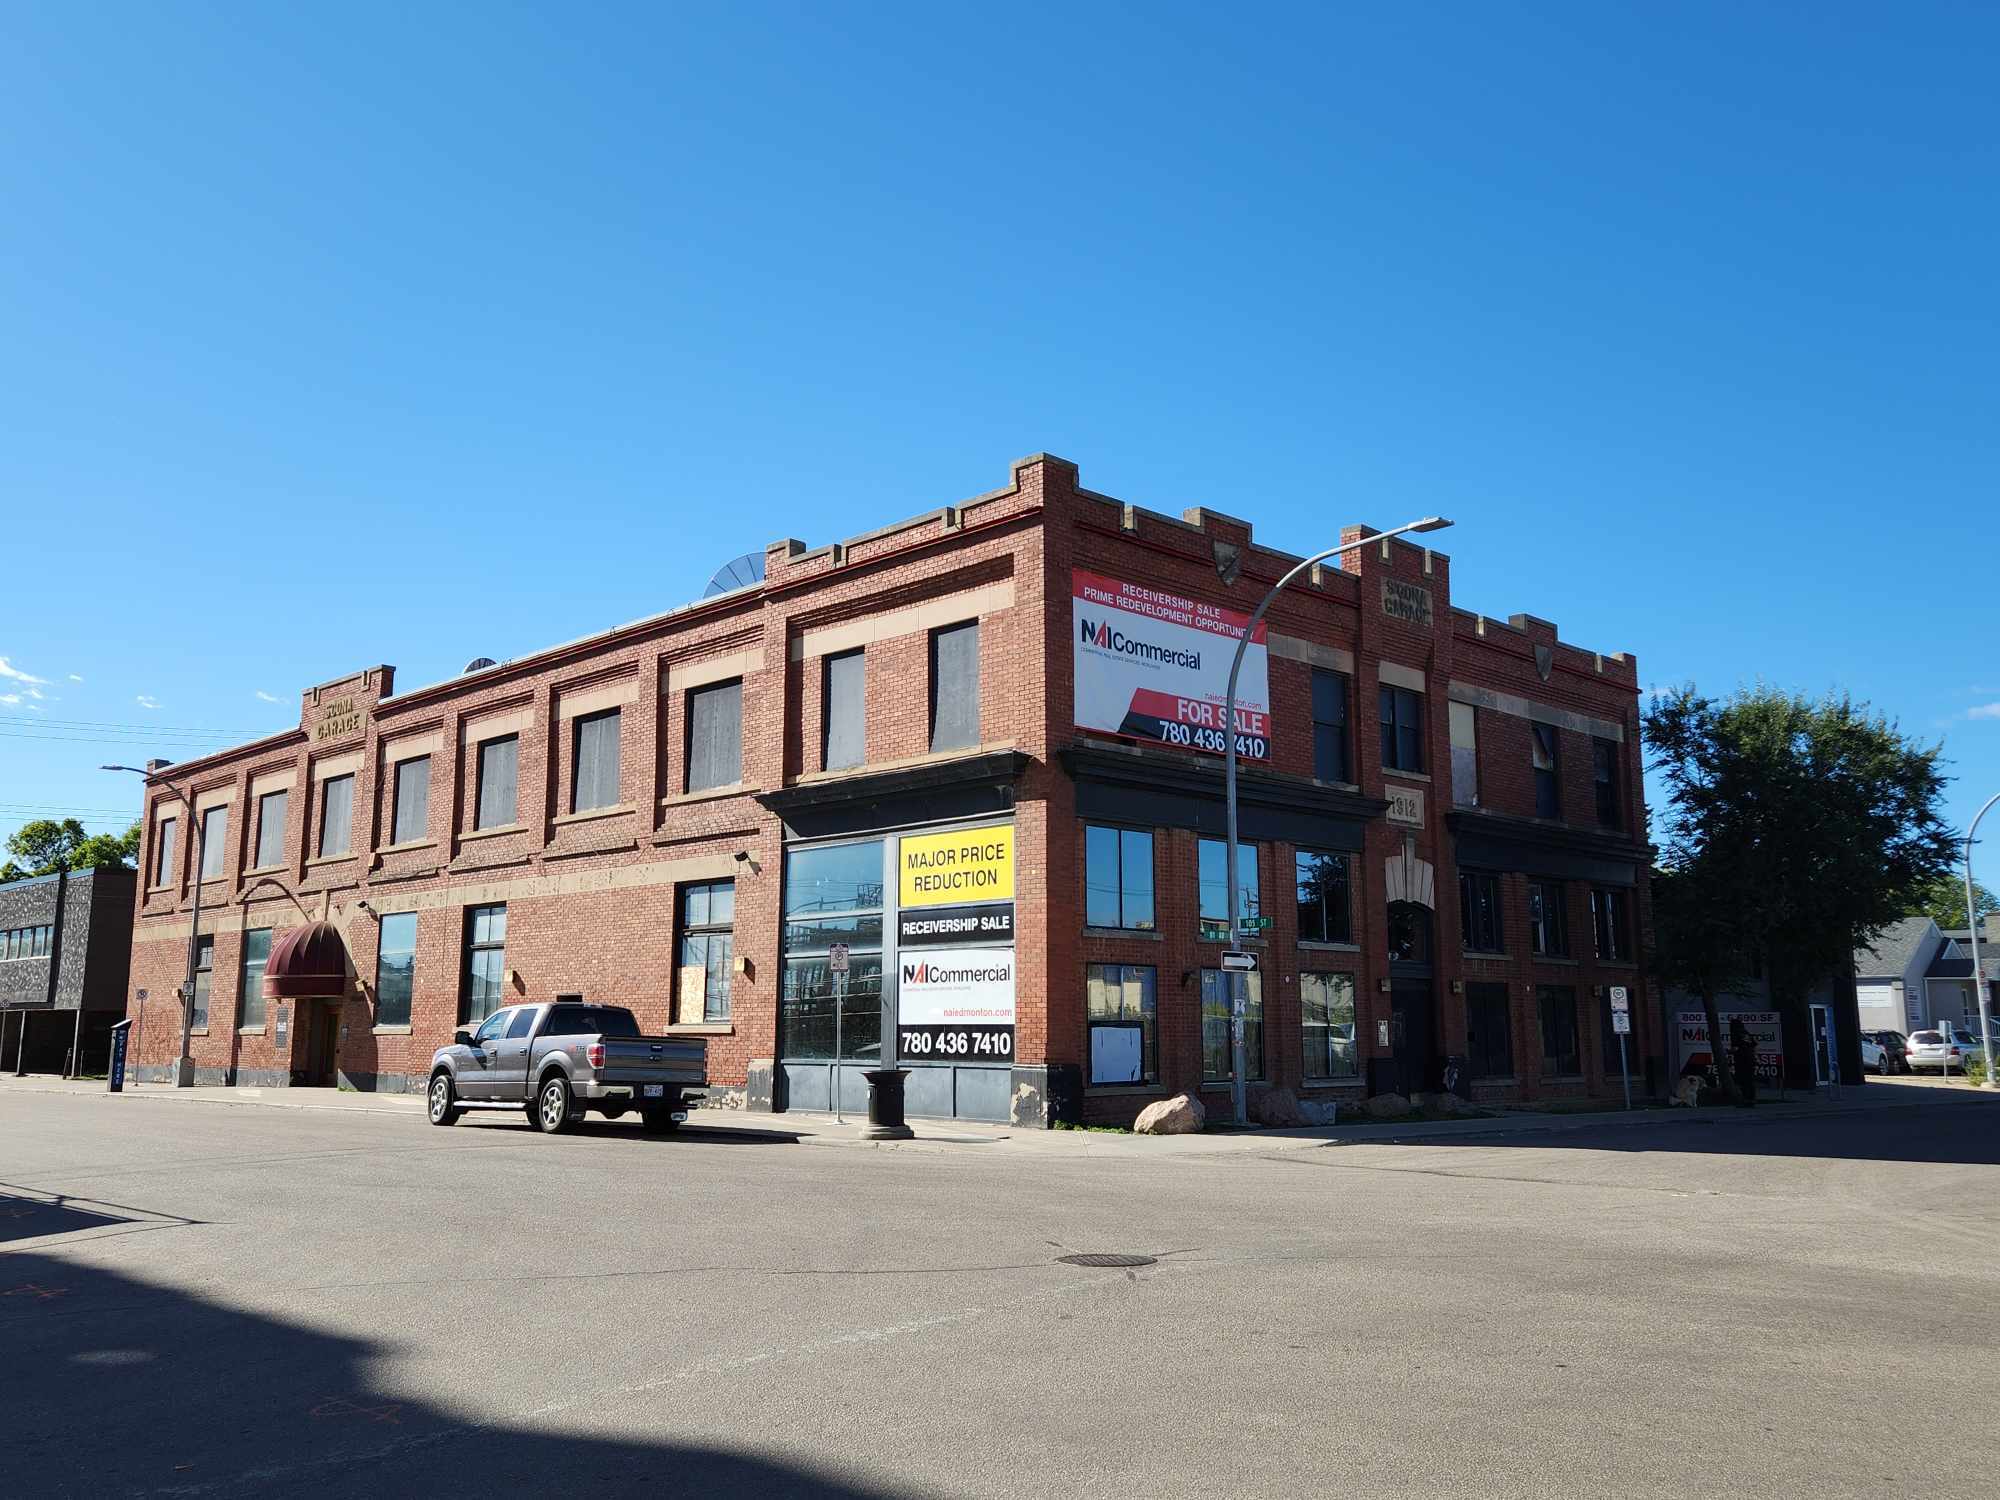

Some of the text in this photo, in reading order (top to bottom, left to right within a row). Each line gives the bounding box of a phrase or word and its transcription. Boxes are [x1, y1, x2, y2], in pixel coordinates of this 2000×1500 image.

[1084, 587, 1114, 605] PRIME
[1116, 596, 1193, 625] REDEVELOPMENT
[1122, 583, 1220, 619] RECEIVERSHIP SALE
[1177, 699, 1213, 726] FOR
[318, 713, 360, 739] GARAGE
[1160, 720, 1190, 745] 780
[1194, 728, 1225, 751] 436
[1391, 796, 1417, 817] 1912
[908, 843, 1005, 869] MAJOR PRICE
[914, 869, 997, 892] REDUCTION
[902, 916, 1010, 935] RECEIVERSHIP SALE
[943, 1007, 1012, 1017] naiedmonton.com
[902, 1032, 1011, 1054] 780 436 7410
